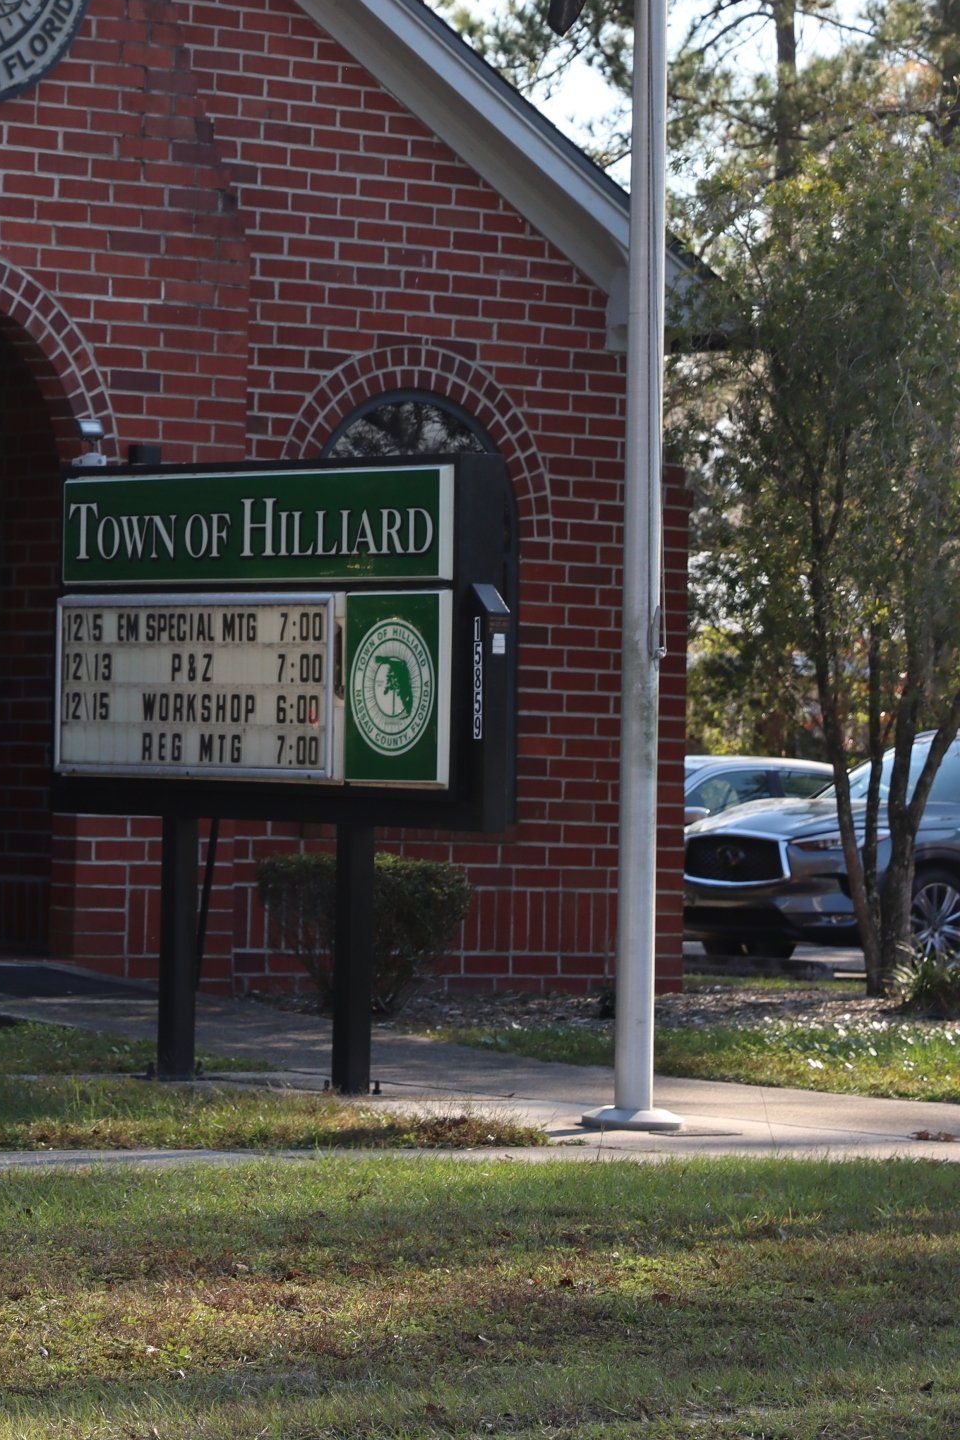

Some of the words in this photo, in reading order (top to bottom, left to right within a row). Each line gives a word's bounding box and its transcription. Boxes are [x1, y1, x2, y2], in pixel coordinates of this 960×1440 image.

[69, 502, 177, 559] TOWN
[185, 513, 231, 558] OF
[240, 497, 433, 556] HILLIARD
[117, 614, 138, 641] EM
[146, 613, 215, 642] SPECIAL
[223, 613, 256, 641] MTG
[280, 612, 322, 642] 7:00
[357, 643, 375, 671] TOWN
[377, 629, 388, 640] OF
[393, 628, 426, 667] HILLIARD
[172, 654, 181, 681] P
[188, 654, 195, 681] &
[202, 654, 212, 681] Z
[277, 654, 322, 683] 7:00
[474, 617, 482, 739] 15859
[142, 693, 255, 722] WORKSHOP
[276, 695, 318, 723] 6:00
[356, 689, 373, 734] NASSAU
[412, 680, 430, 733] FLORIDA
[142, 733, 182, 761] REG
[200, 734, 241, 762] MTG
[277, 736, 318, 765] 7:00
